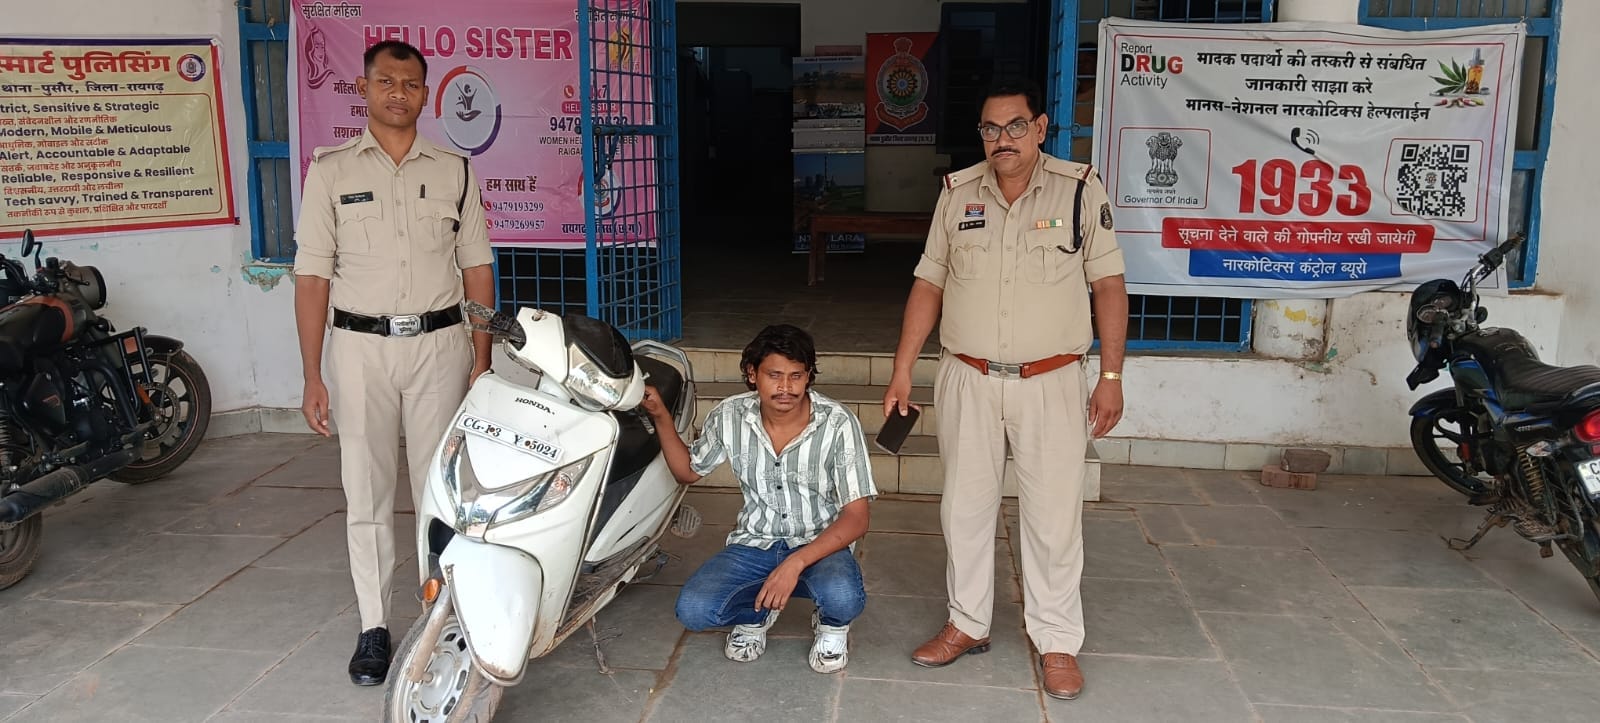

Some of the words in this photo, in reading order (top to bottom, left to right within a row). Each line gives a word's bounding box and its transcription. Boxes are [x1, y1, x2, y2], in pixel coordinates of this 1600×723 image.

[302, 2, 331, 19] सुरक्षित
[333, 2, 362, 17] महिला
[363, 25, 457, 58] HELLO
[464, 26, 573, 61] SISTER
[1121, 43, 1152, 54] Report
[60, 50, 170, 80] पुलिसिंग
[1121, 54, 1183, 74] DRUG
[1197, 52, 1236, 65] मादक
[1287, 49, 1307, 67] की
[1311, 51, 1355, 68] तस्करी
[1360, 53, 1373, 69] से
[1377, 53, 1427, 70] संबधित
[1120, 73, 1168, 89] Activity
[1245, 74, 1307, 92] जानकारी
[1311, 80, 1348, 95] साझा
[1352, 77, 1373, 93] करे
[33, 102, 90, 113] Sensitive
[93, 103, 102, 111] &
[105, 101, 160, 113] Strategic
[350, 105, 368, 117] हमार
[1282, 100, 1363, 118] नारकोटिक्स
[1367, 101, 1430, 122] हेल्पलाईन
[51, 126, 93, 135] Mobile
[96, 126, 104, 134] &
[107, 124, 172, 134] Meticulous
[539, 136, 568, 145] WOMEN
[0, 151, 33, 160] Alert,
[36, 148, 115, 159] Accountable
[118, 147, 126, 155] &
[129, 145, 190, 157] Adaptable
[2, 173, 56, 183] Reliable,
[62, 169, 131, 182] Responsive
[134, 169, 142, 177] &
[145, 166, 194, 177] Resilient
[485, 179, 501, 191] हम
[504, 179, 525, 192] साथ
[1232, 159, 1372, 216] 1933
[4, 196, 36, 206] Tech
[38, 195, 79, 206] savvy,
[82, 192, 128, 202] Trained
[131, 191, 139, 199] &
[142, 187, 213, 200] Transparent
[1124, 195, 1162, 204] Governor
[1165, 196, 1175, 204] Of
[1178, 196, 1198, 205] India
[492, 202, 544, 212] 9479193299
[494, 219, 544, 230] 9479269957
[1178, 228, 1214, 245] सूचना
[1218, 225, 1238, 242] देने
[1243, 226, 1269, 243] वाले
[1273, 228, 1291, 243] की
[1297, 227, 1342, 244] गोपनीय
[1347, 228, 1371, 244] रखी
[1376, 229, 1416, 245] जायेगी
[1223, 256, 1295, 273] नारकोटिक्स
[1299, 258, 1336, 277] कंट्रोल
[1341, 258, 1367, 278] ब्यूरो
[515, 397, 551, 413] HONDA
